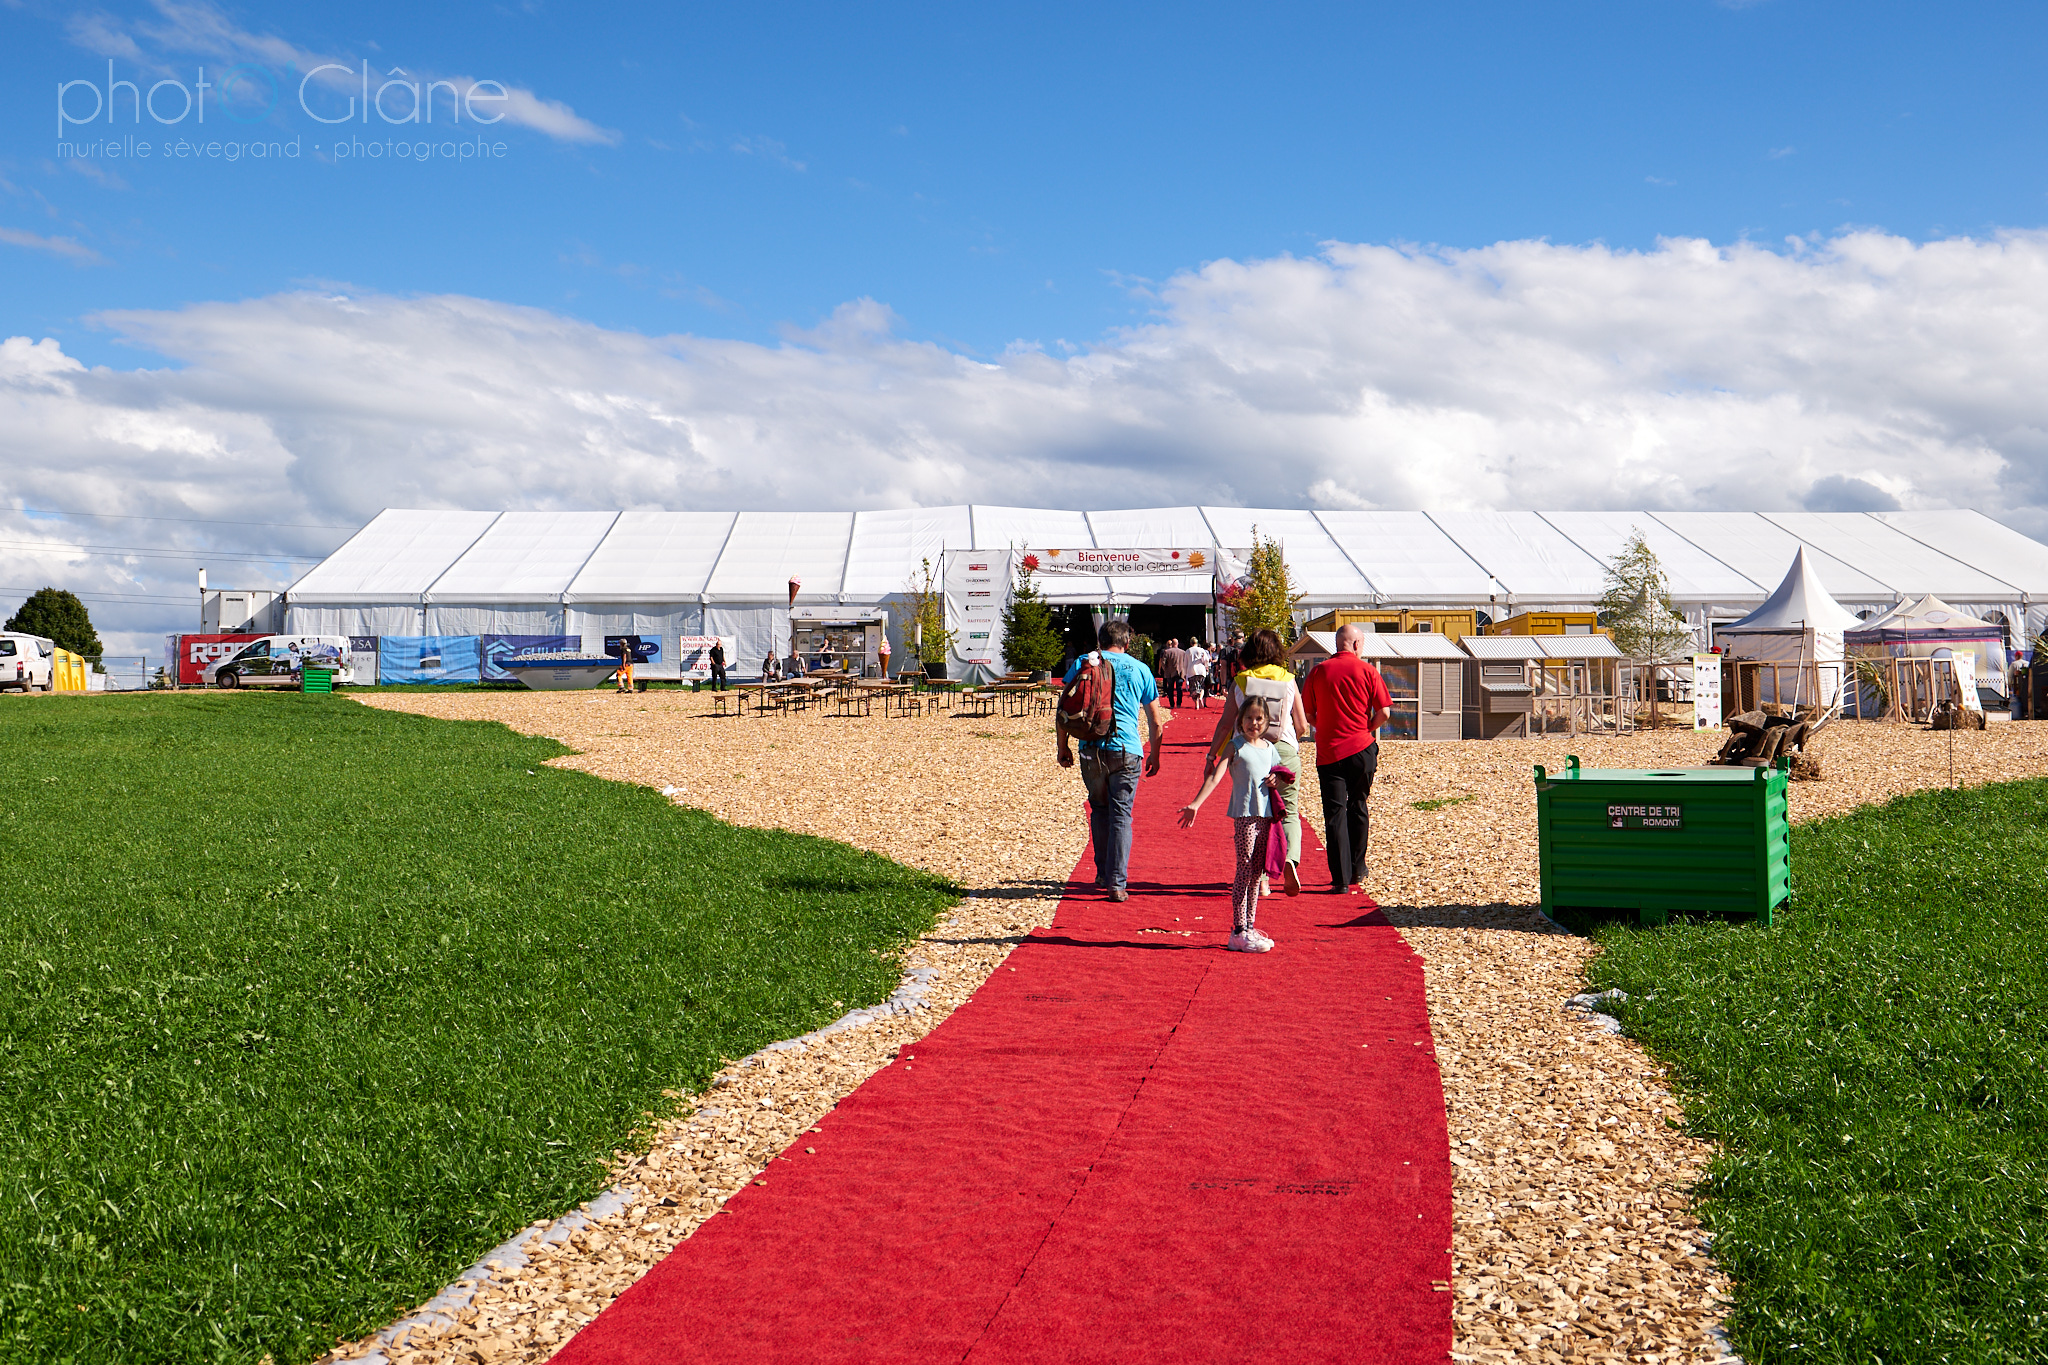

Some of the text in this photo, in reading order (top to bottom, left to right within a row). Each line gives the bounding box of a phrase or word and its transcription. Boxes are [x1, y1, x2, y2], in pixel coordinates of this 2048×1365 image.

[1078, 552, 1140, 562] Bienvenue
[1049, 562, 1179, 574] au Comptoir de la Glâne
[358, 639, 372, 649] SA
[1608, 806, 1680, 817] CENTRE DE TRI
[1642, 818, 1680, 826] ROMONT
